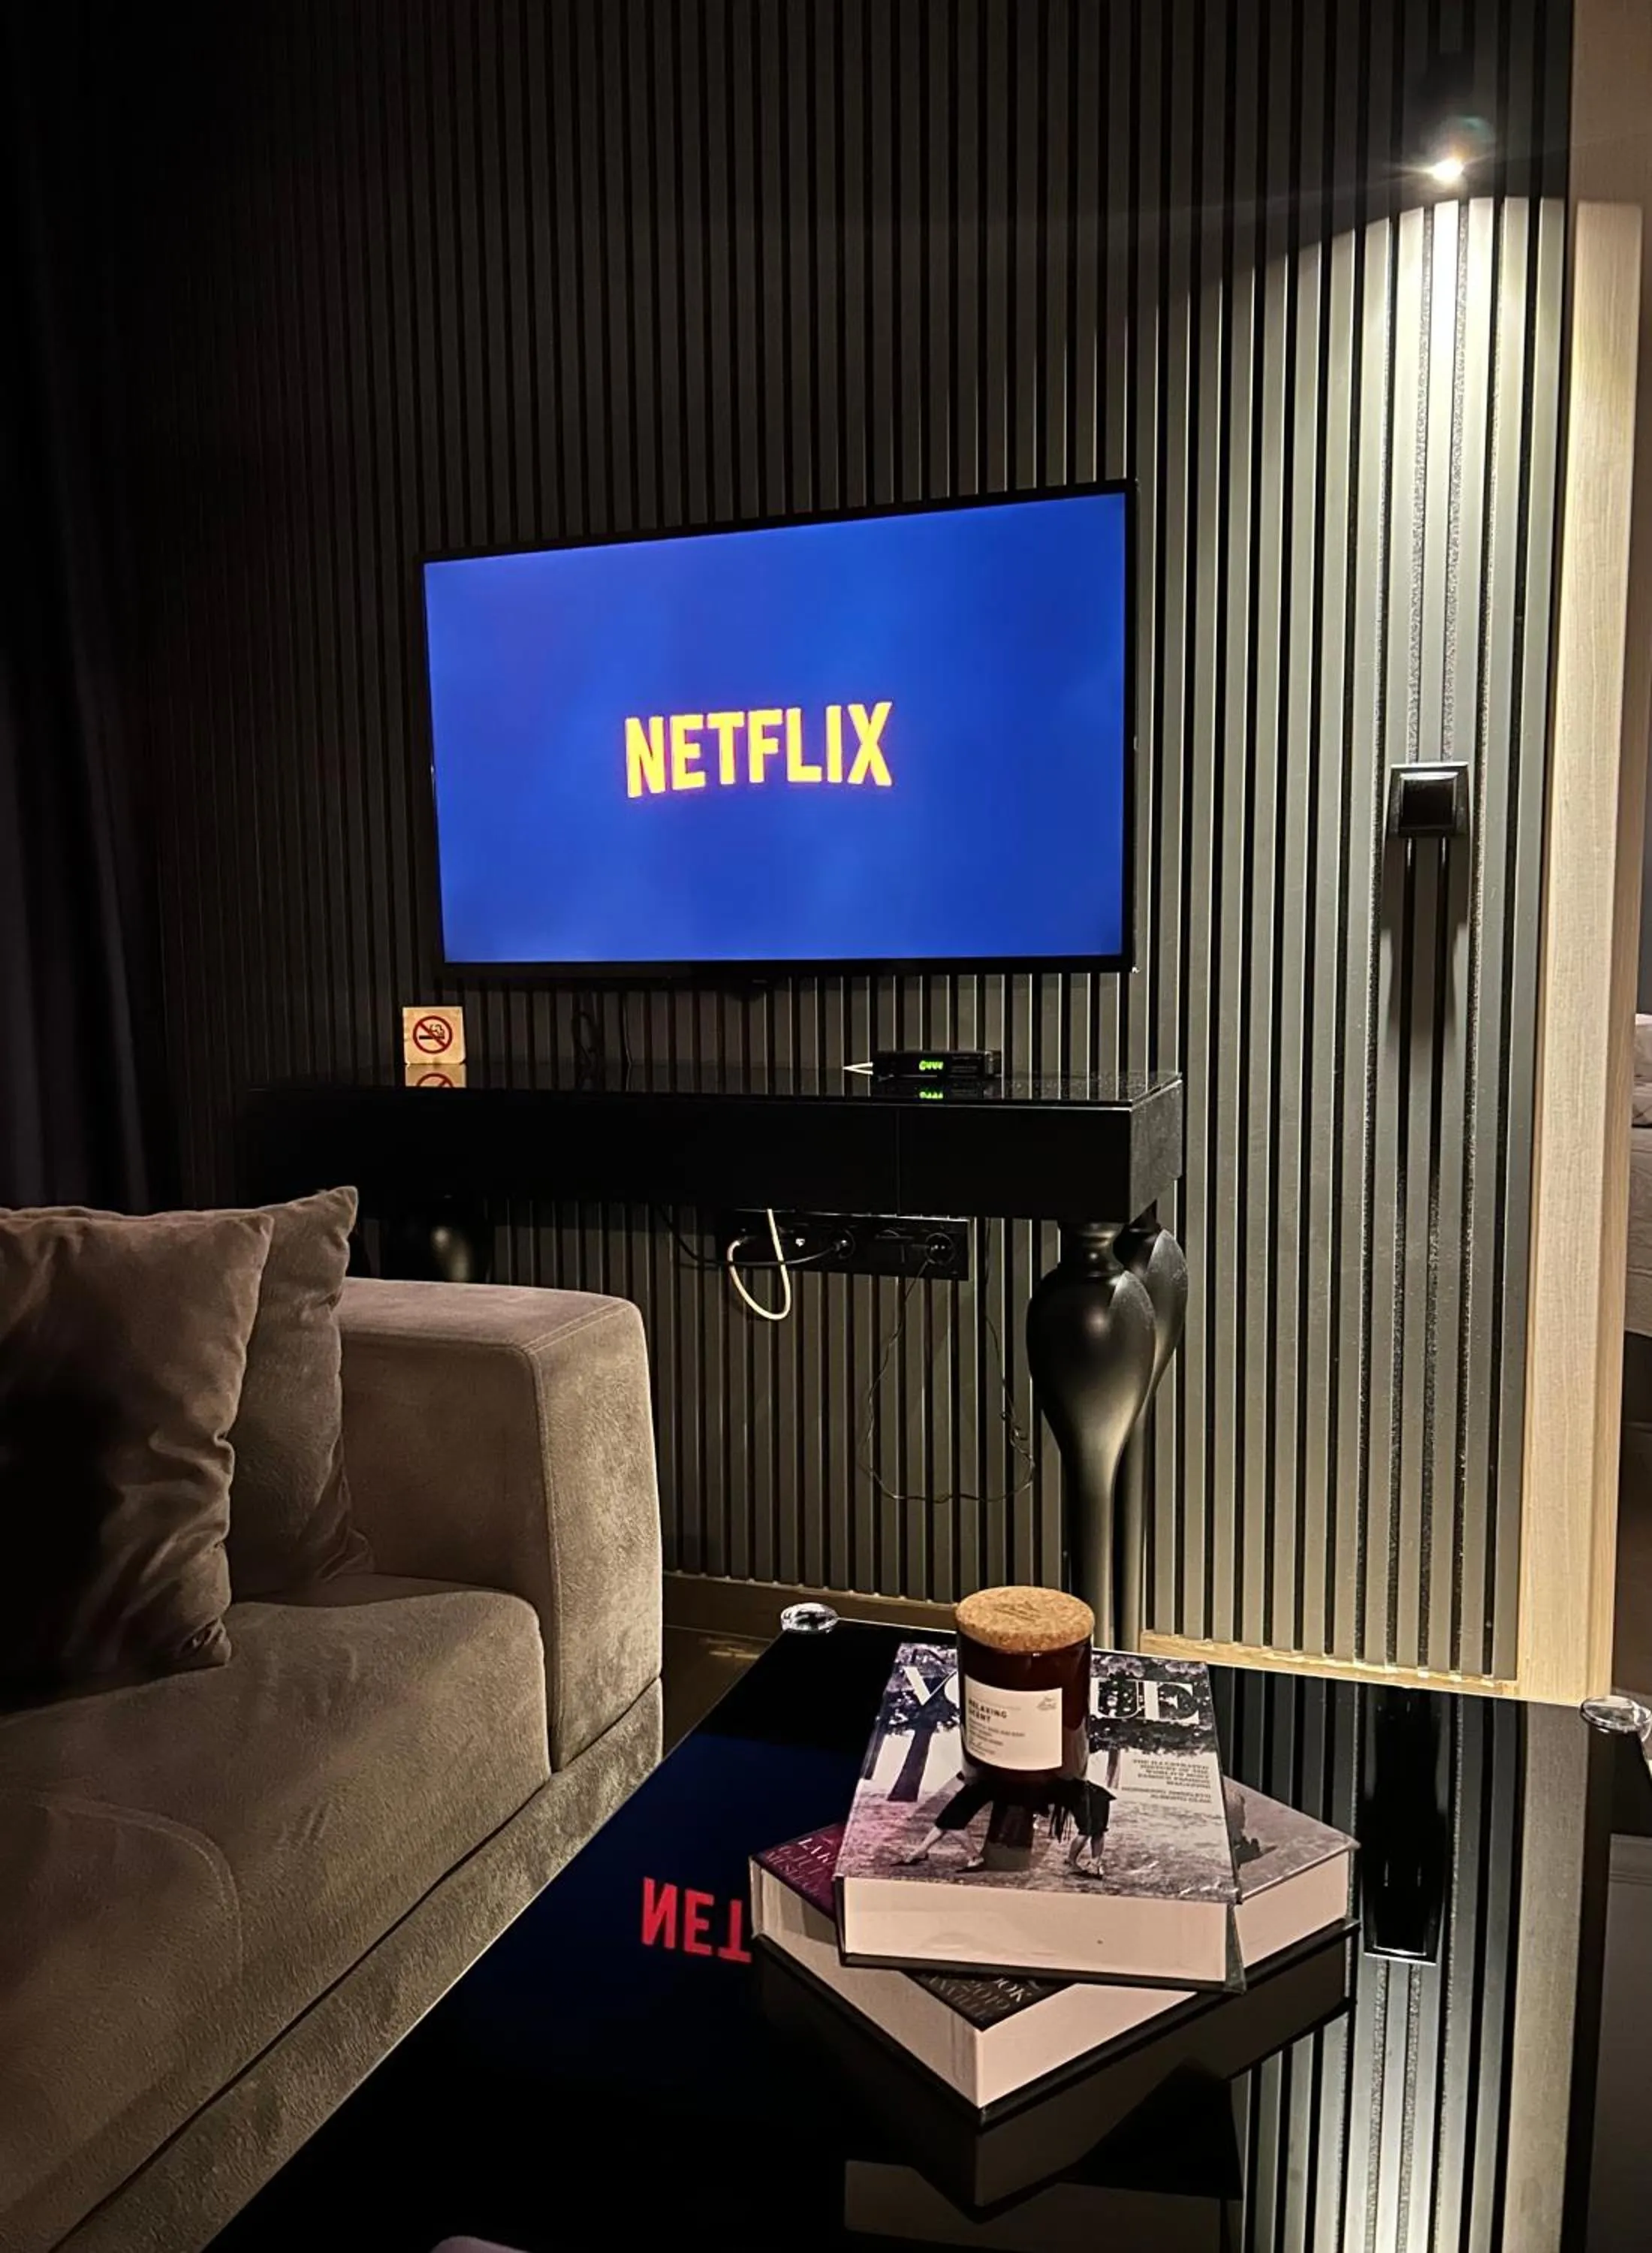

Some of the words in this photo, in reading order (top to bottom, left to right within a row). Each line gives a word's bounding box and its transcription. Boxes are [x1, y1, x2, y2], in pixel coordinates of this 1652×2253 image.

[625, 701, 893, 798] NETFLIX
[903, 1666, 1200, 1726] VUE
[969, 1698, 1008, 1719] RELAXING
